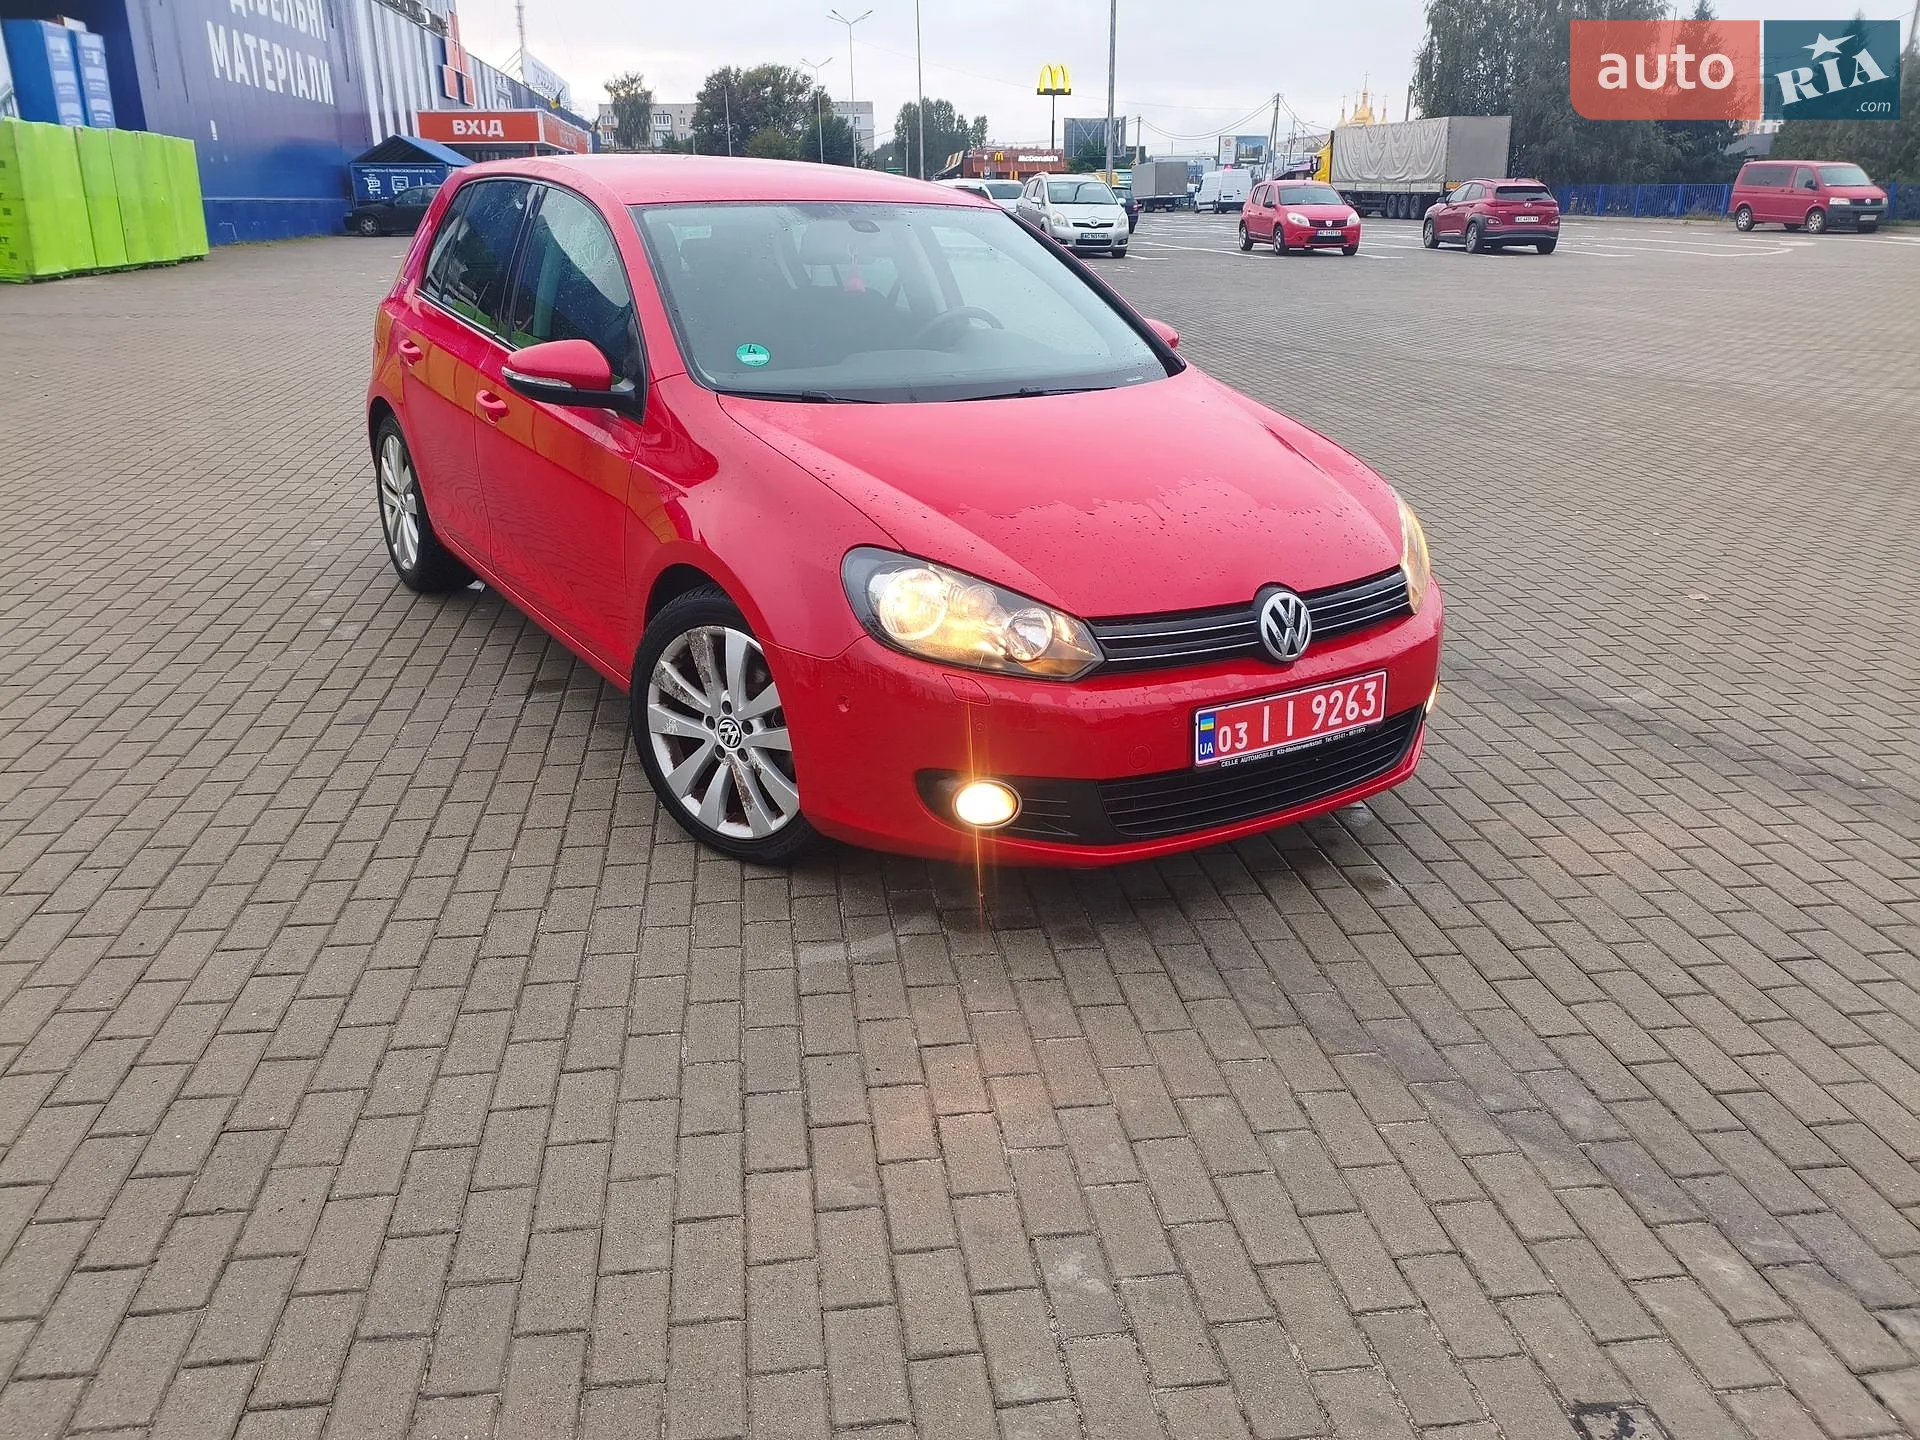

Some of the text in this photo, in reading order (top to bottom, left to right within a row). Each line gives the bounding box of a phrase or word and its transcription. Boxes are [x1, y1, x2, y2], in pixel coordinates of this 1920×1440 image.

[206, 19, 334, 105] МАТЕРІАЛИ
[452, 119, 505, 137] ВХІД
[1218, 721, 1248, 752] 03
[1311, 680, 1377, 731] 9263
[1199, 741, 1214, 755] UA
[1221, 759, 1239, 768] CELLE
[1240, 750, 1274, 763] AUTOMOBILE
